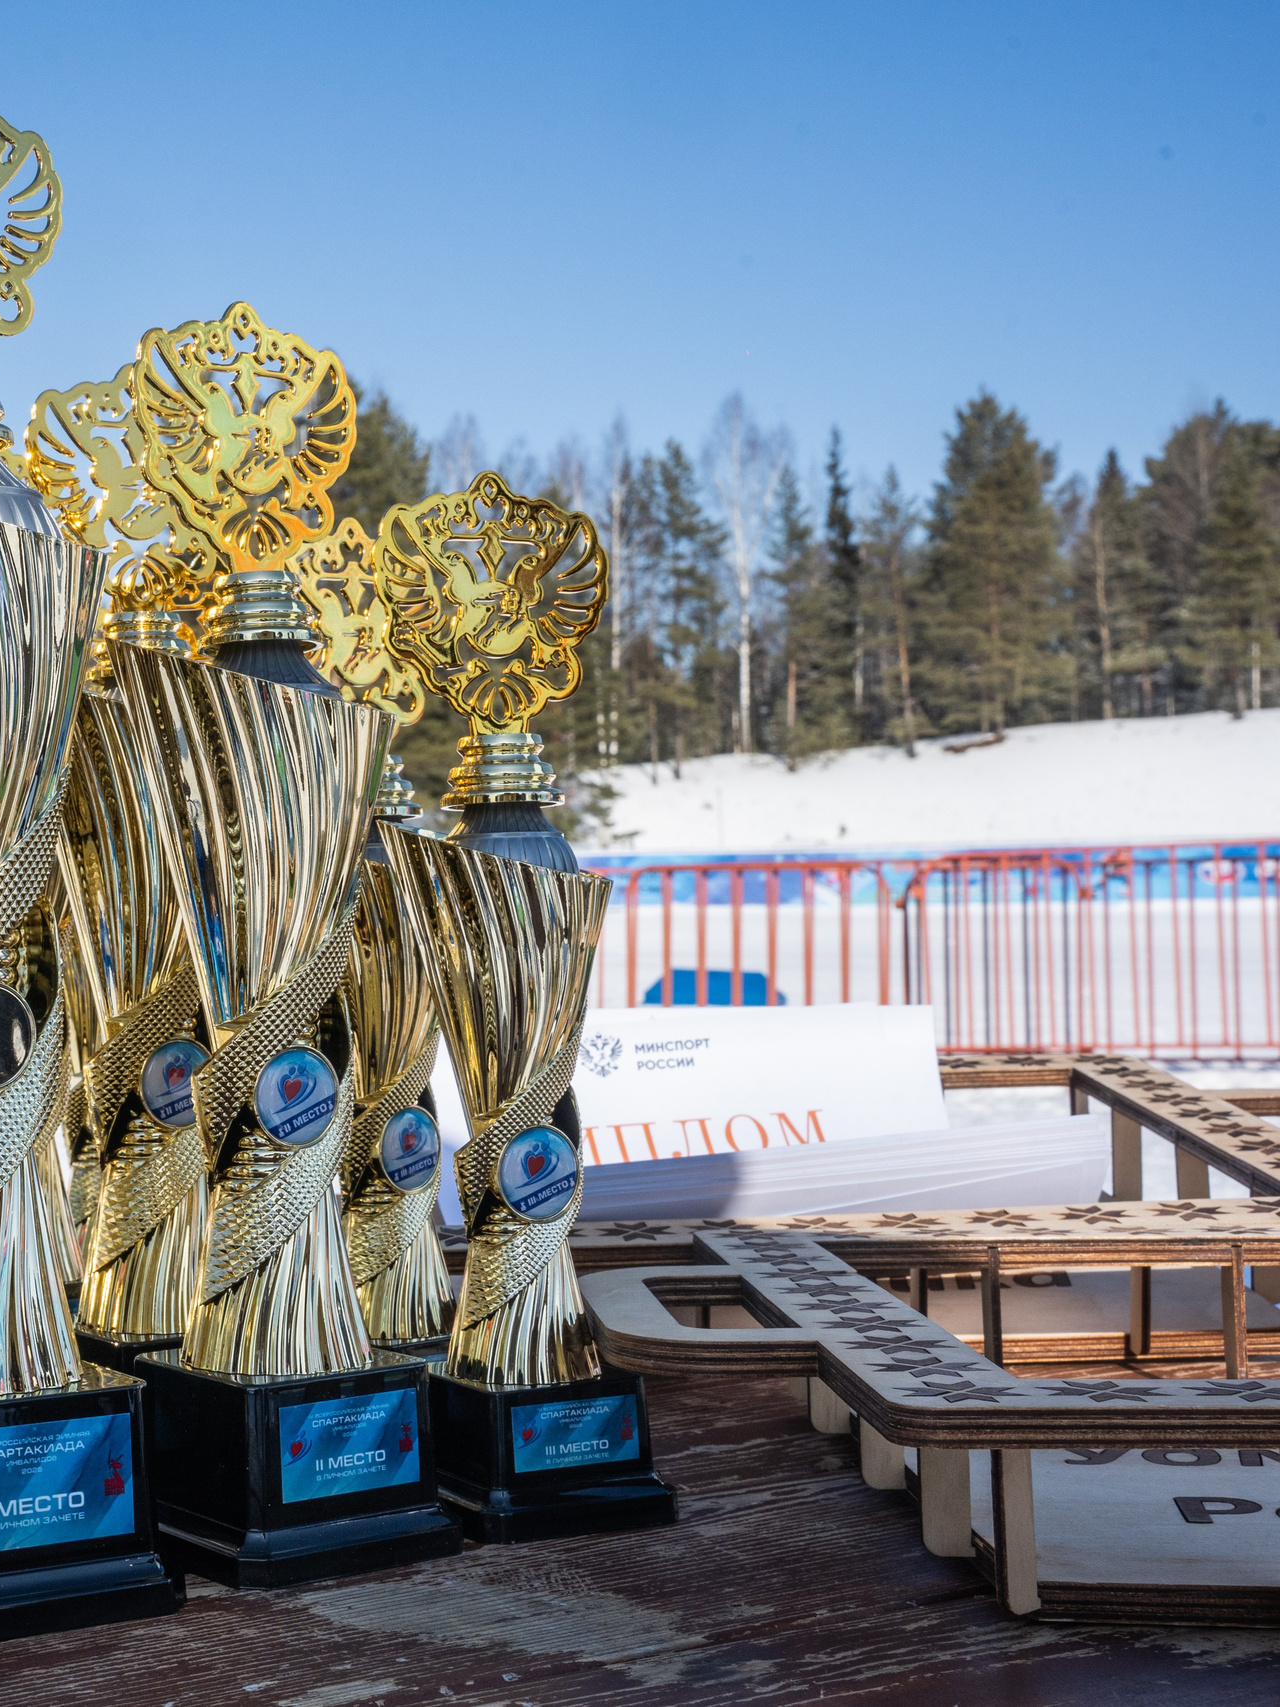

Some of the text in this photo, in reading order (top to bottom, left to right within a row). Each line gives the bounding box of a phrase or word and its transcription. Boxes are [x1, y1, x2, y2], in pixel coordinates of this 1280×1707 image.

[635, 1038, 711, 1054] МИНСПОРТ
[637, 1057, 695, 1071] РОССИИ
[284, 1103, 327, 1133] II МЕСТО
[408, 1158, 432, 1173] МЕСТО
[527, 1180, 568, 1206] III МЕСТО
[312, 1410, 385, 1427] СПАРТАКИАДА
[540, 1406, 609, 1419] СПАРТАКИАДА
[545, 1439, 609, 1456] III МЕСТО
[6, 1455, 57, 1467] ИНВАЛИДОВ
[315, 1450, 386, 1471] II МЕСТО
[323, 1470, 356, 1480] ЛИЧНОМ
[358, 1465, 387, 1475] ЗАЧЕТЕ
[42, 1512, 85, 1525] ЗАЧЕТЕ
